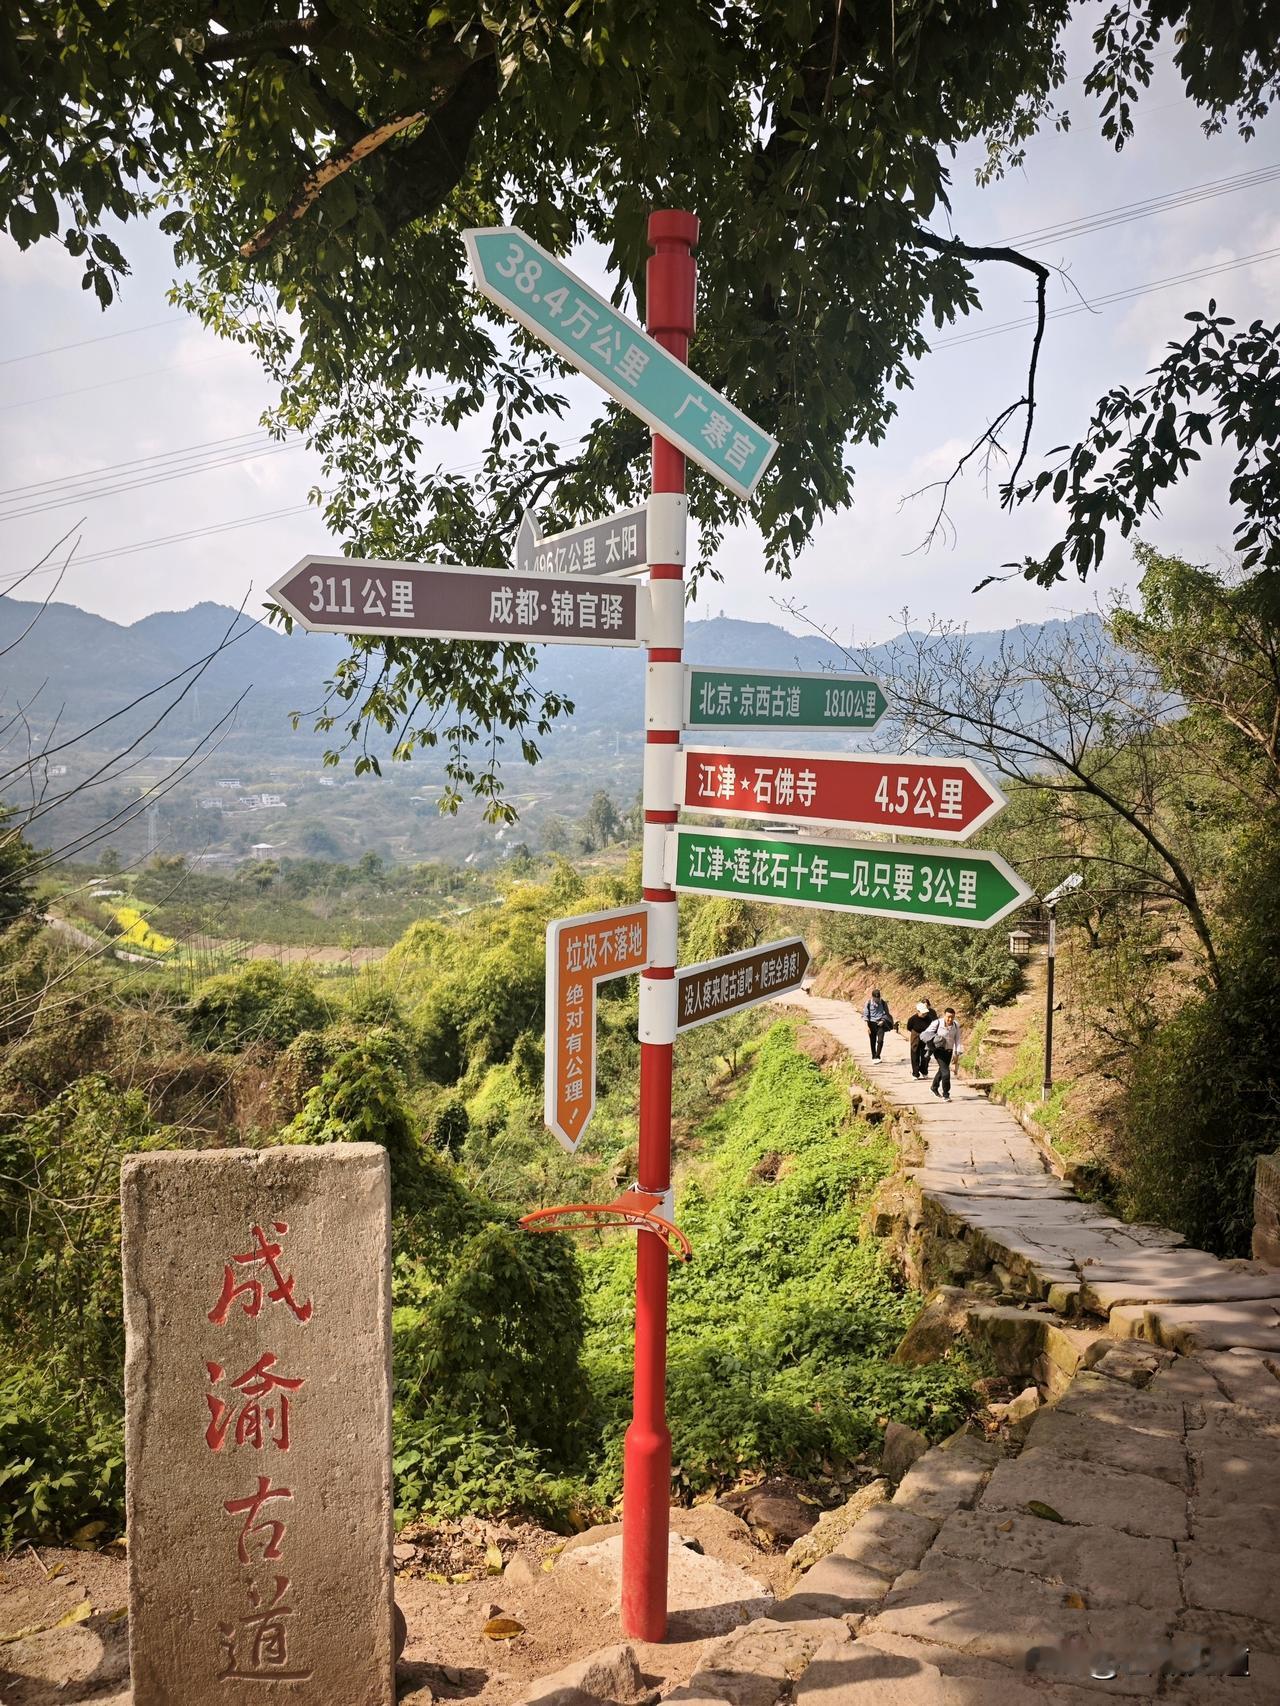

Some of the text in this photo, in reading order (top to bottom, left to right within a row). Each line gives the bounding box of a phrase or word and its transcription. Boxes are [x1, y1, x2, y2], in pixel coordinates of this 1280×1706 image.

[496, 243, 756, 472] 38.4万公里 广寒宫
[605, 524, 637, 564] 太阳
[489, 587, 624, 630] 成都·锦官驿
[699, 682, 877, 719] 北京·京西古道 1810公里
[874, 775, 964, 820] 4.5公里
[566, 922, 643, 973] 垃圾不落地
[206, 1221, 313, 1681] 成渝古道
